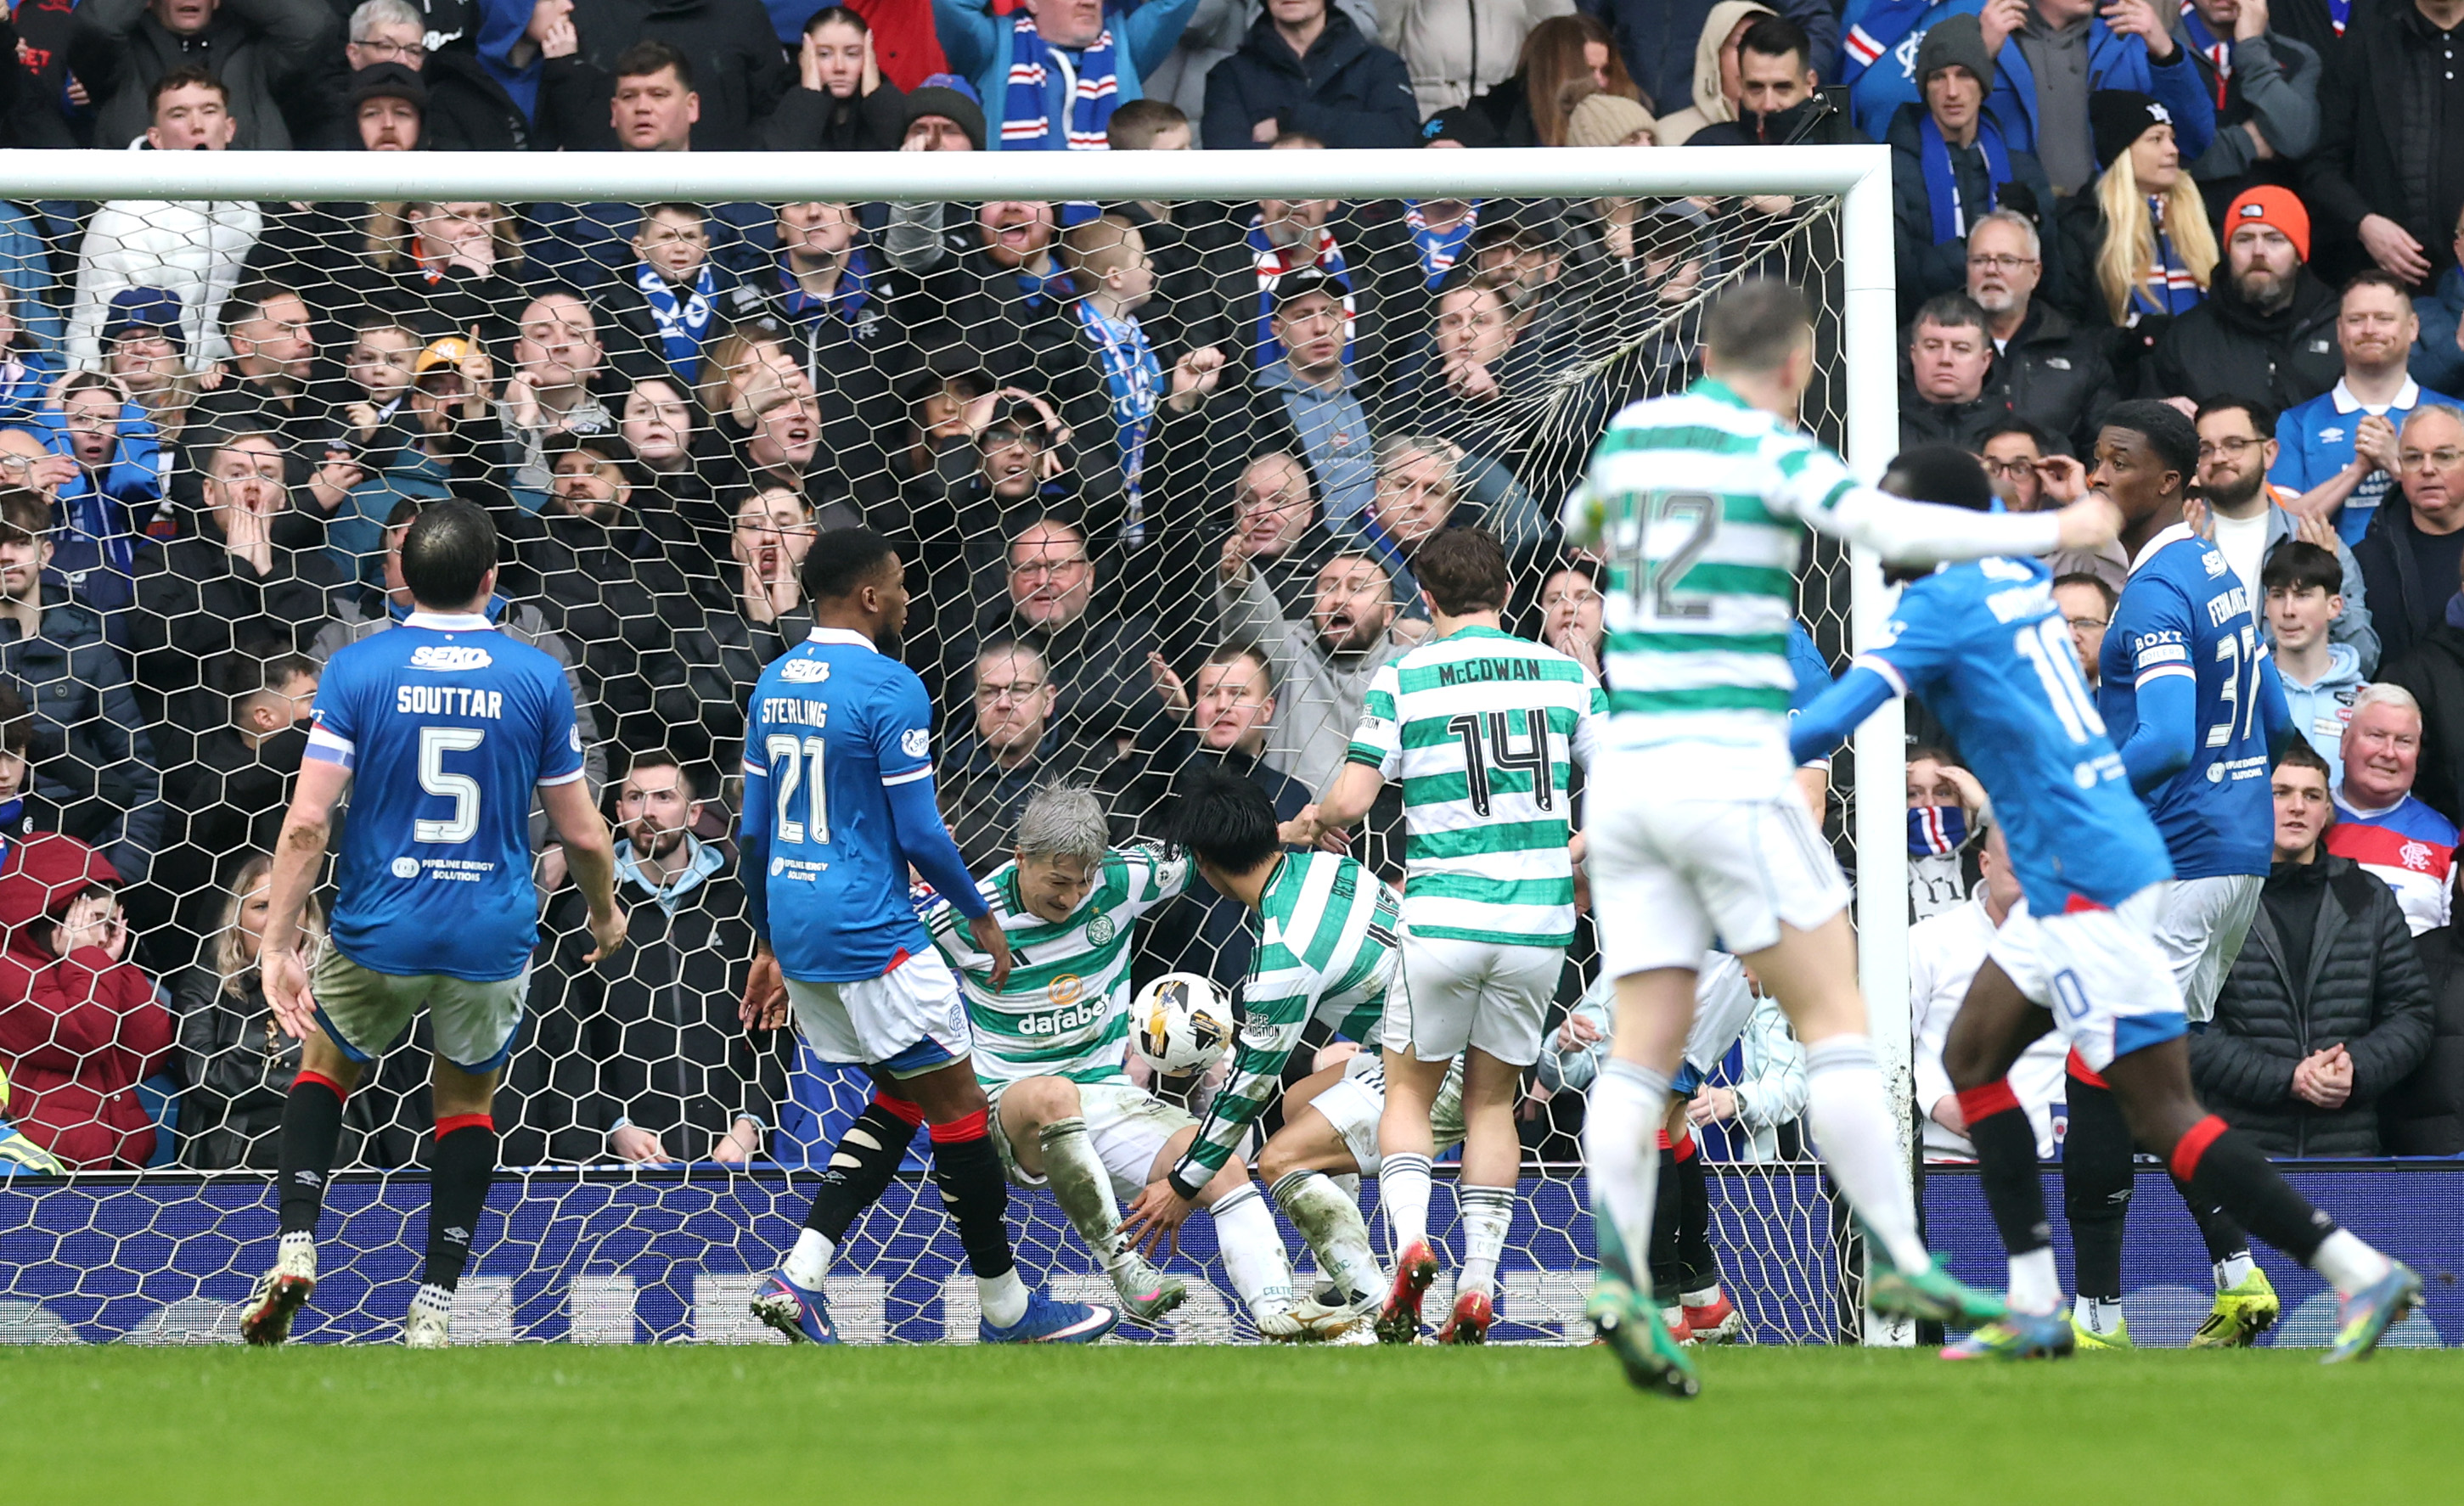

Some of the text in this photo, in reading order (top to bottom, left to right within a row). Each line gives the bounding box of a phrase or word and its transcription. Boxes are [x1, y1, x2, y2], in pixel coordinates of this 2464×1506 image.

[411, 646, 491, 669] SEKO
[2135, 631, 2182, 652] BOXT
[2141, 648, 2182, 663] BOILERS
[780, 659, 830, 680] SEKO
[1438, 659, 1541, 687] McCOWAN
[2013, 615, 2107, 745] 10
[397, 686, 502, 719] SOUTTAR
[2205, 625, 2262, 749] 37
[762, 698, 828, 728] STERLING
[1447, 707, 1554, 818] 14
[414, 727, 485, 843] 5
[766, 734, 830, 845] 21
[1018, 993, 1111, 1036] dafabet
